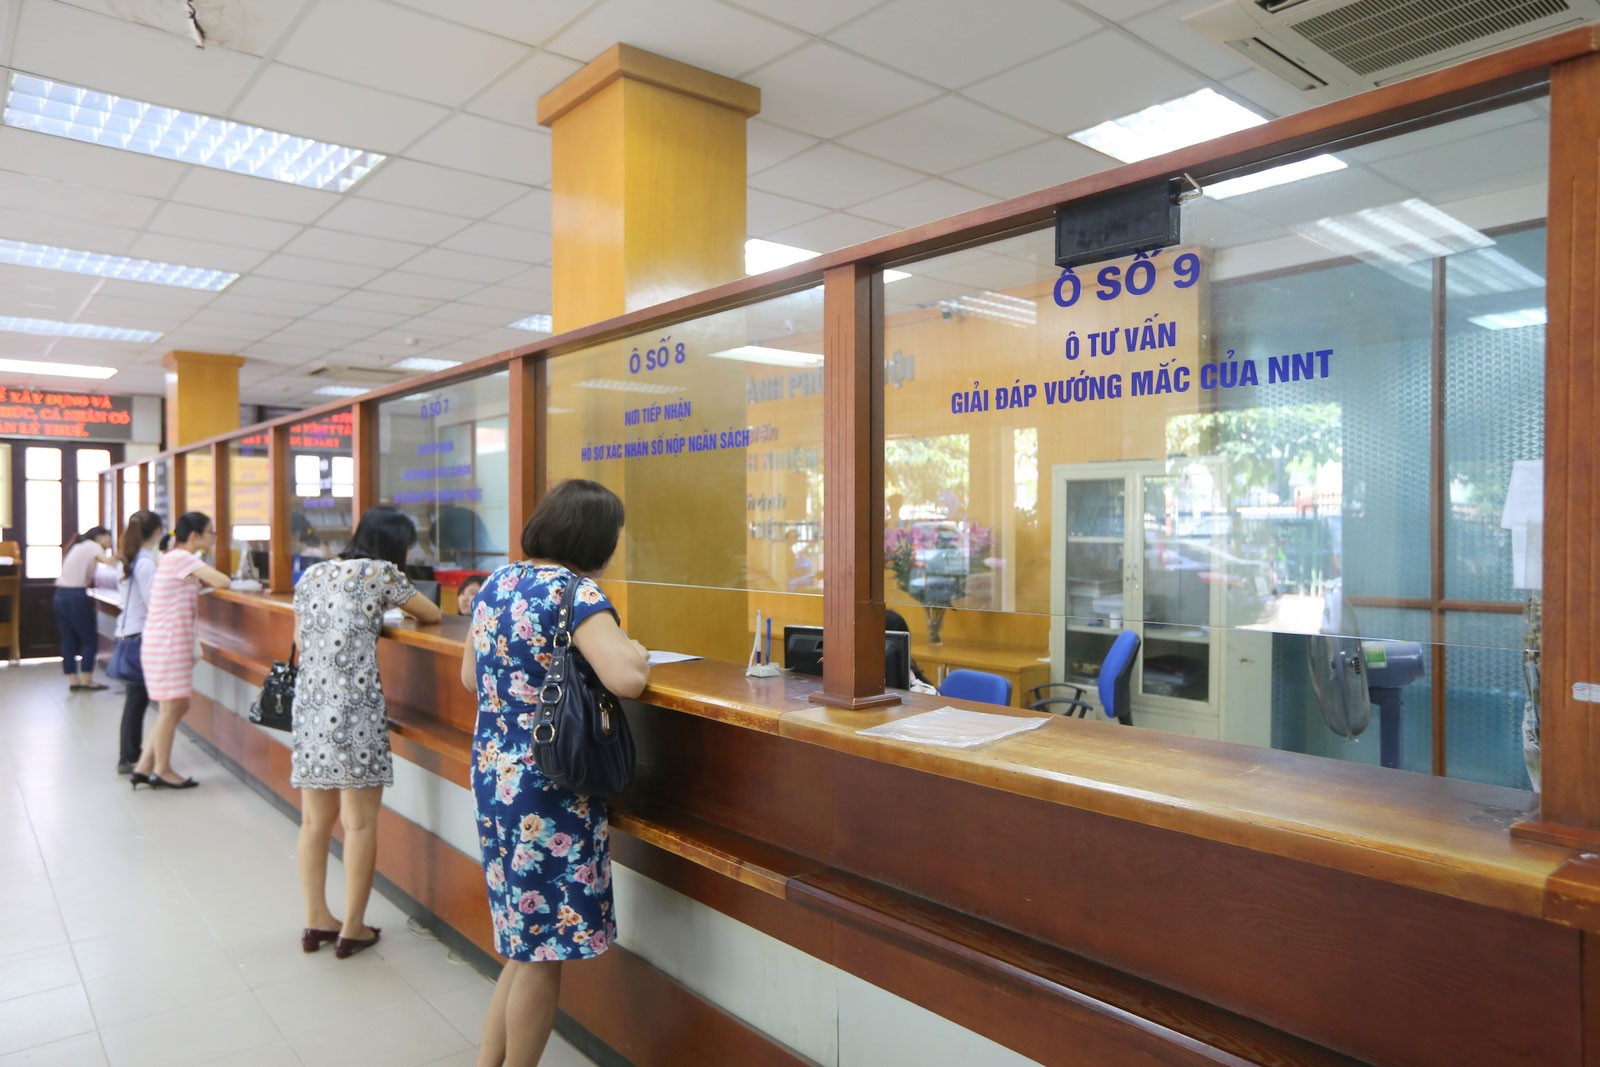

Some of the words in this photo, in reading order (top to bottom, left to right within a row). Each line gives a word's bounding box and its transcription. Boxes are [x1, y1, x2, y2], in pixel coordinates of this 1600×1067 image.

[1053, 267, 1081, 307] Ô
[1096, 249, 1161, 301] SỐ
[1173, 252, 1201, 289] 9
[629, 347, 641, 374] Ô
[646, 336, 671, 371] SỐ
[675, 342, 686, 364] 8
[1065, 331, 1080, 360] Ô
[1087, 327, 1120, 357] TƯ
[1124, 313, 1177, 353] VẤN
[951, 381, 989, 414] GIẢI
[995, 379, 1037, 410] ĐÁP
[1044, 370, 1122, 405] VƯỚNG
[1131, 358, 1190, 397] MẮC
[1200, 349, 1259, 390] CỦA
[1268, 348, 1334, 384] NNT
[625, 408, 640, 426] NƠI
[642, 401, 661, 424] TIẾP
[664, 398, 691, 422] NHẬN
[581, 442, 592, 461] HỒ
[606, 440, 622, 459] XÁC
[624, 437, 649, 461] NHẬN
[651, 432, 664, 456] SỐ
[665, 434, 685, 458] NỘP
[688, 430, 717, 452] NGÂN
[720, 426, 750, 449] SÁCH
